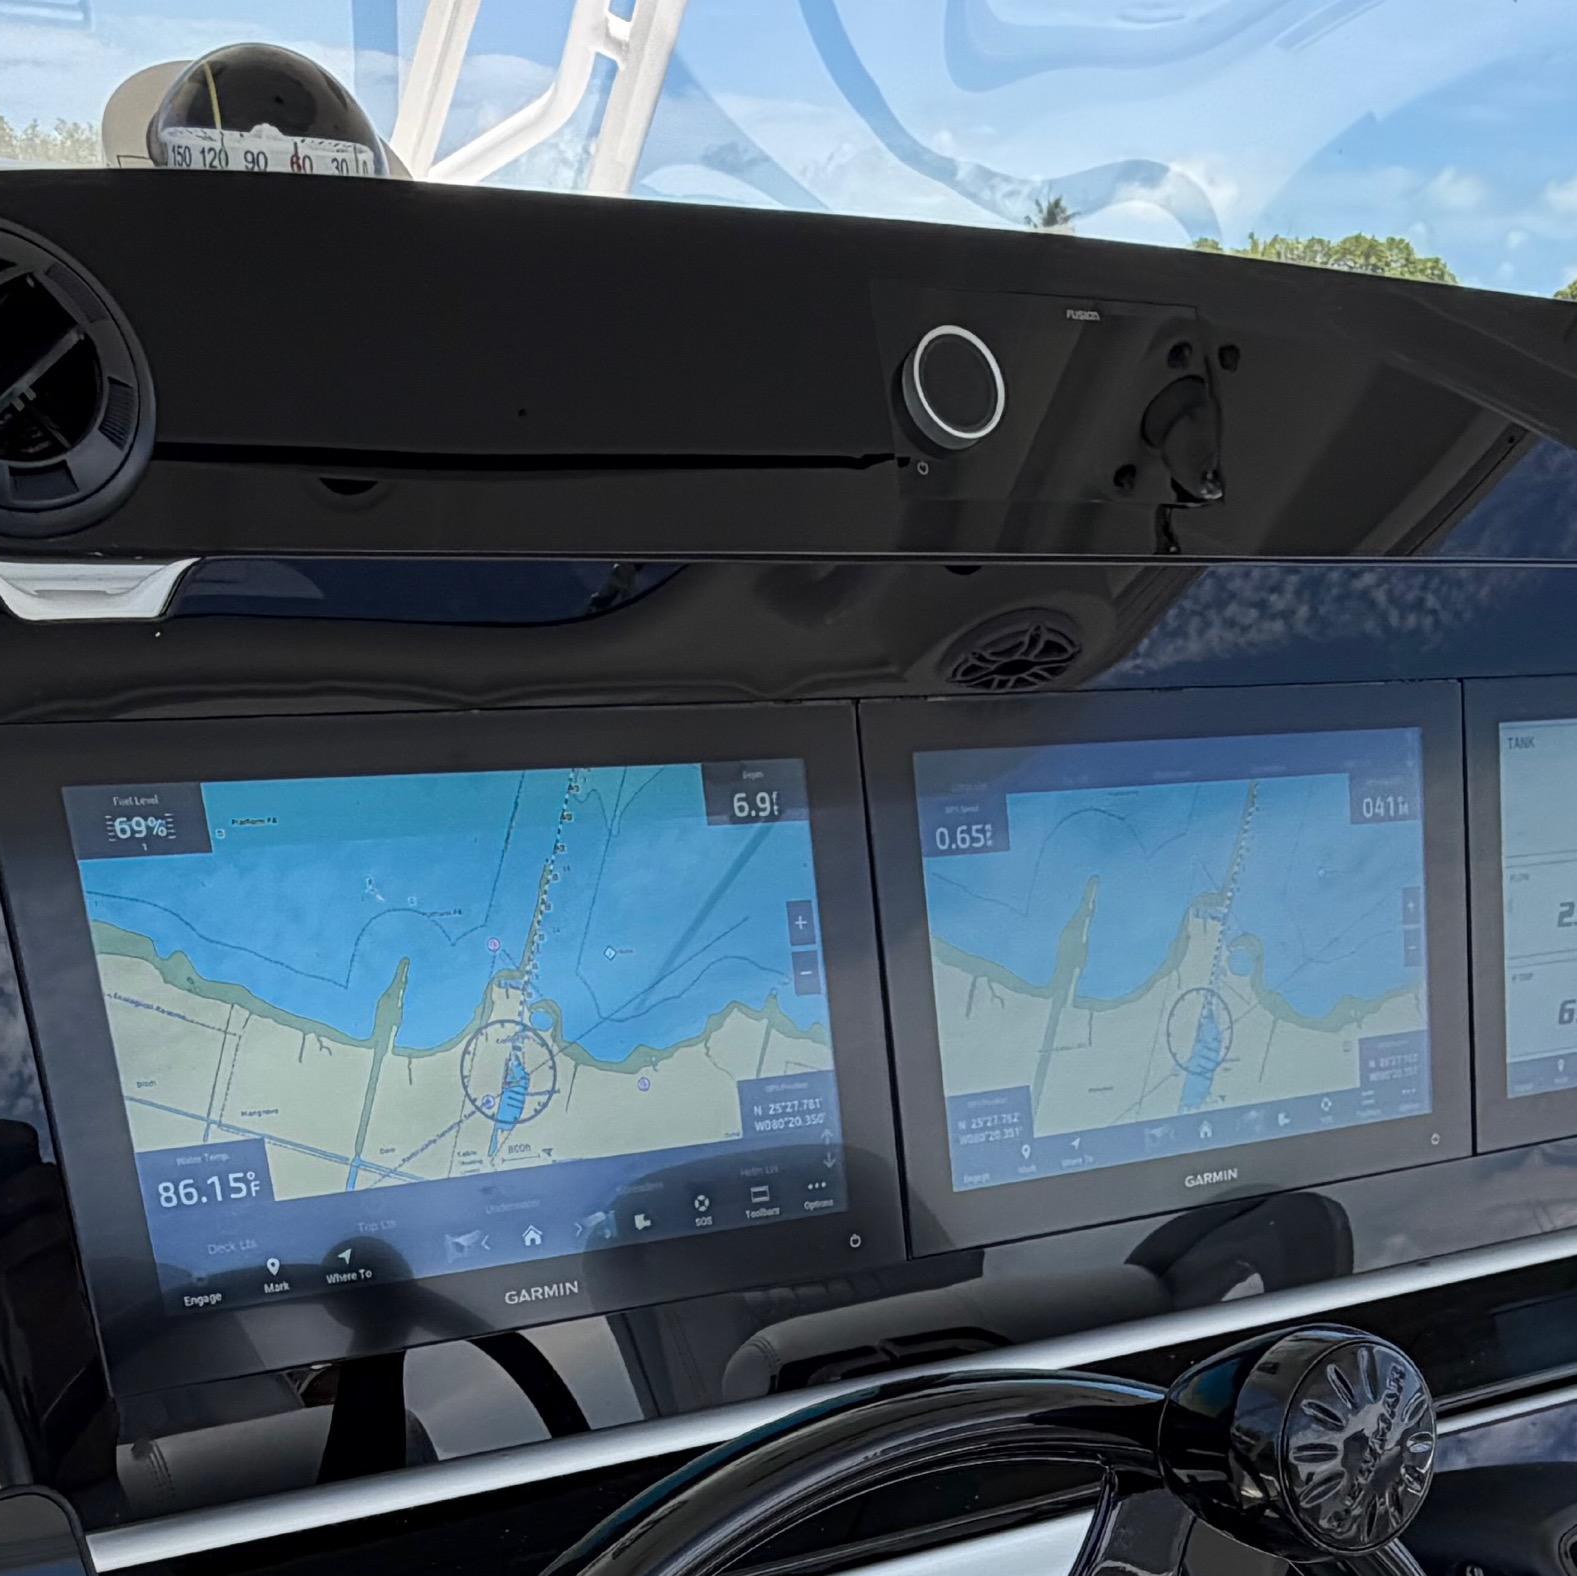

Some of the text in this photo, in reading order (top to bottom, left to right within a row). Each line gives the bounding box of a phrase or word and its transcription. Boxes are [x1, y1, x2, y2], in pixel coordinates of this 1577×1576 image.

[172, 146, 192, 168] 150
[200, 147, 229, 169] 120
[244, 151, 268, 171] 90
[1508, 736, 1535, 749] TANK
[114, 815, 168, 840] 69%
[1184, 1168, 1239, 1188] GARMIN
[695, 1215, 713, 1227] SOS
[207, 1242, 236, 1255] Deck
[326, 1268, 373, 1285] Where To
[263, 1281, 290, 1295] Mark
[504, 1280, 579, 1306] GARMIN
[183, 1291, 223, 1308] Engage
